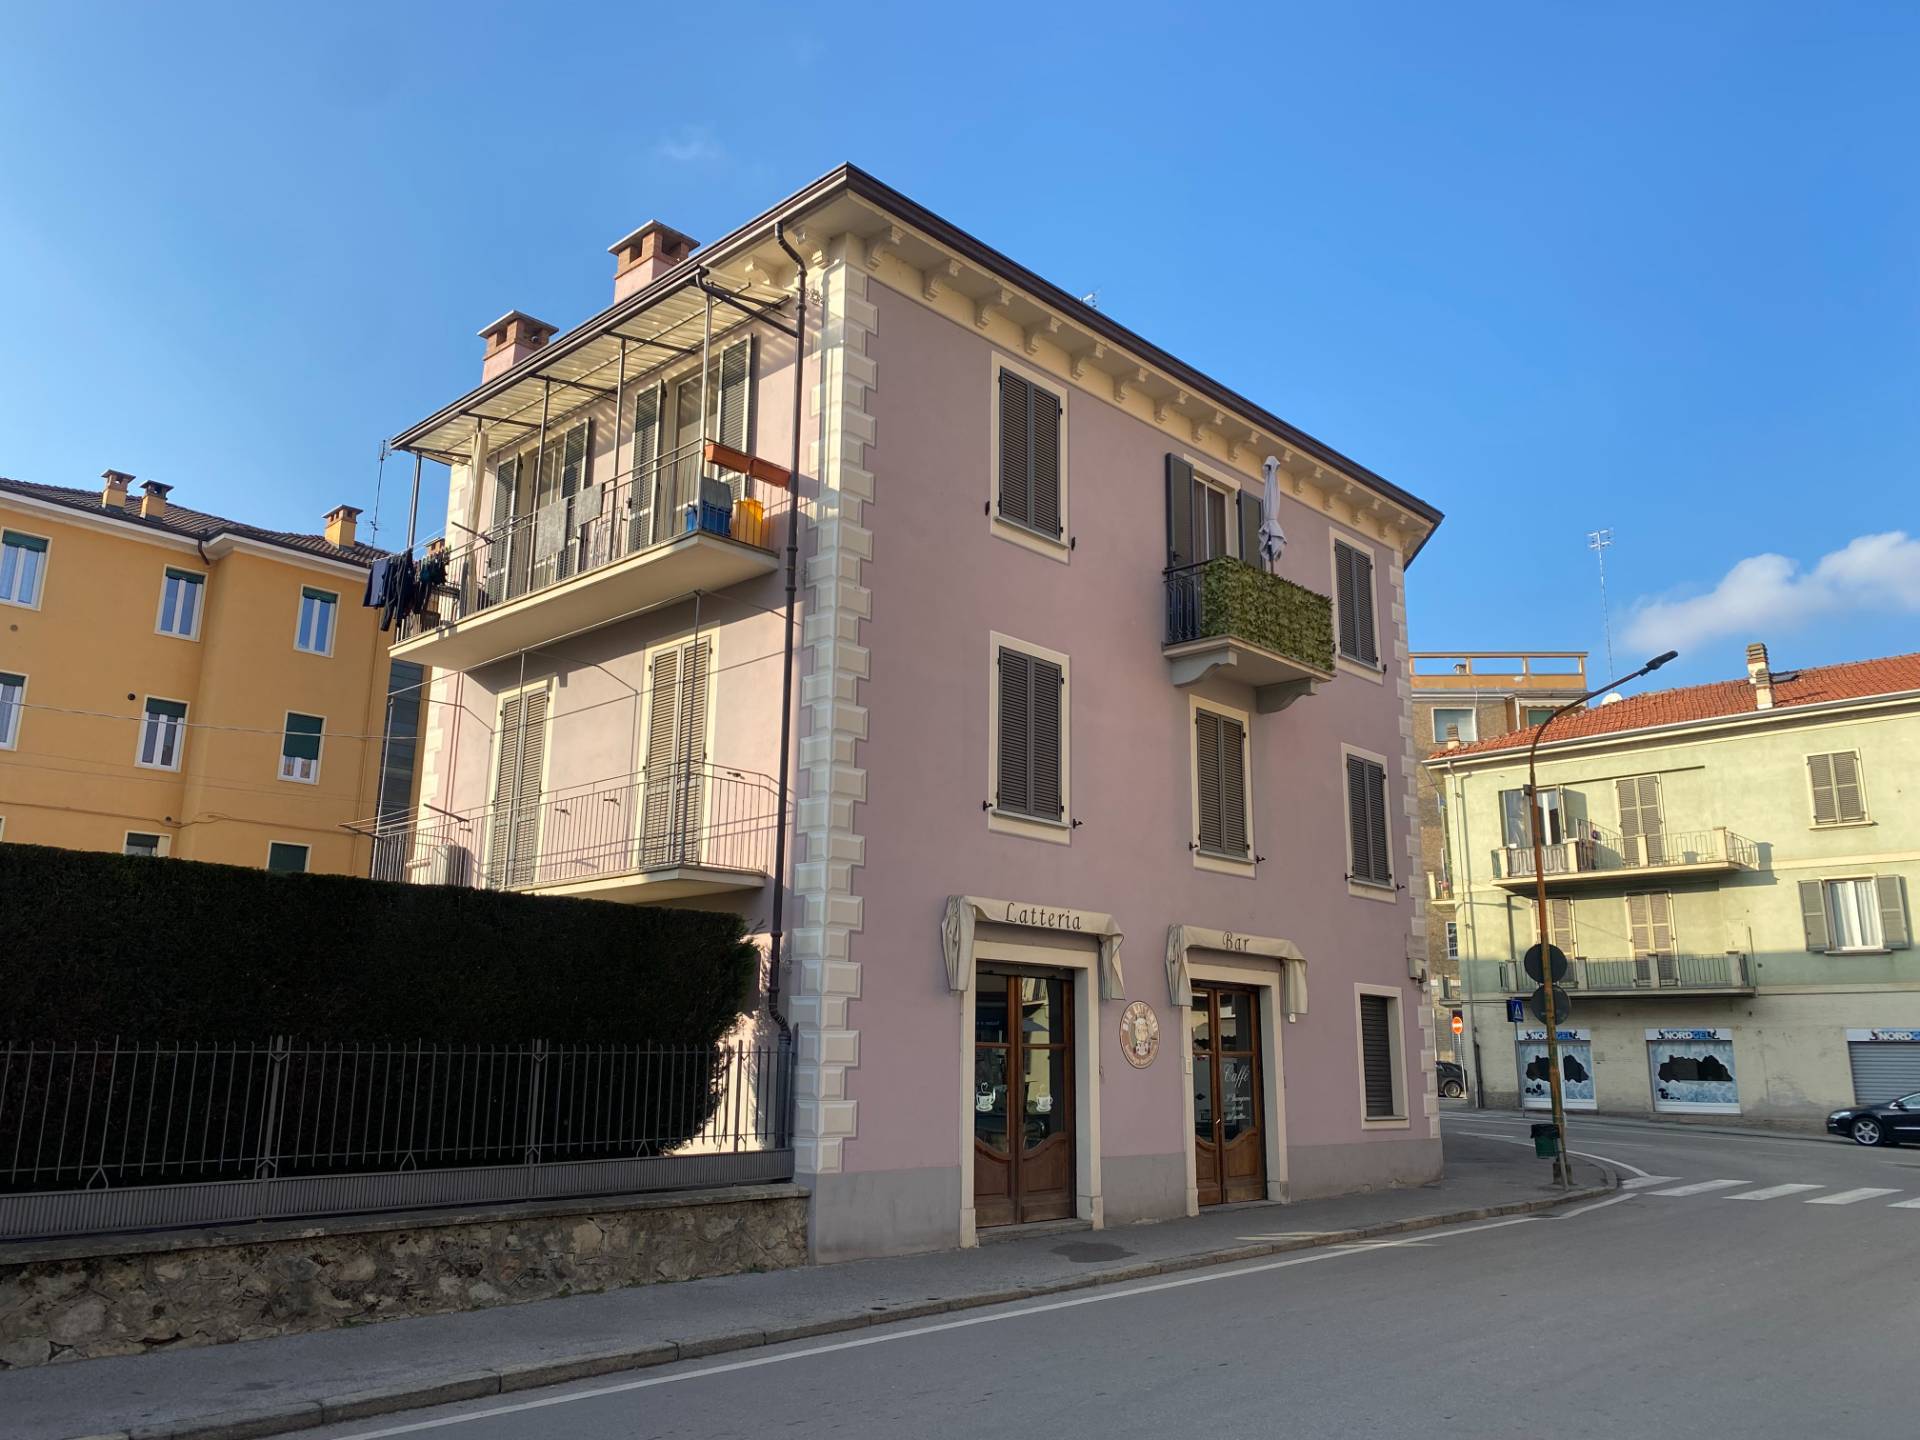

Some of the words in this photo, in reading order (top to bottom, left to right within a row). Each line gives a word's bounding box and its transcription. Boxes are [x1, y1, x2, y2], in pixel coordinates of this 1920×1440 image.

[1005, 902, 1082, 930] Latteria
[1222, 930, 1250, 952] Bar
[1664, 1031, 1712, 1040] NORDGEL
